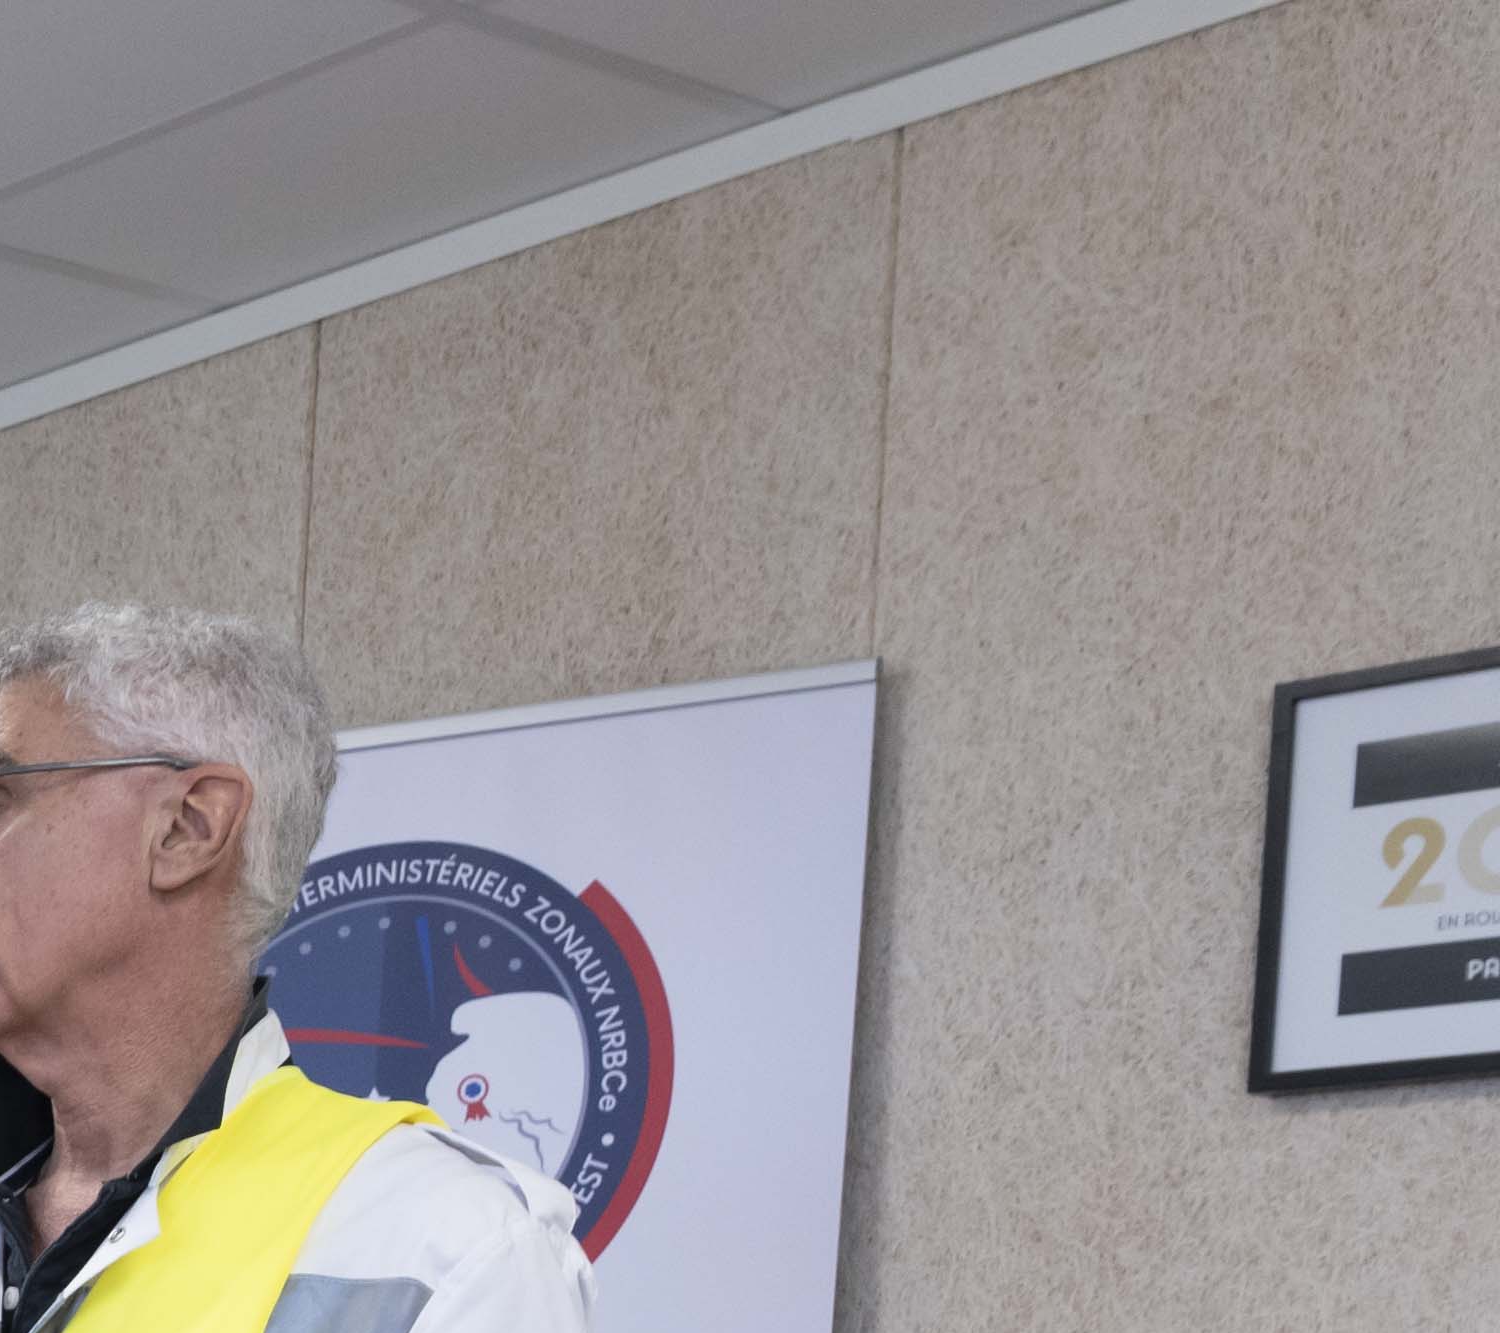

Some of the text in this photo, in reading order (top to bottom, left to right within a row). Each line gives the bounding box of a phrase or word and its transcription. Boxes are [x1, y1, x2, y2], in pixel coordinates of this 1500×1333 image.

[1437, 914, 1460, 931] EN
[287, 853, 628, 1113] ERMINISTÉRIELS ZONAUX NRBCe
[1465, 957, 1500, 981] PA
[570, 1152, 609, 1210] EST
